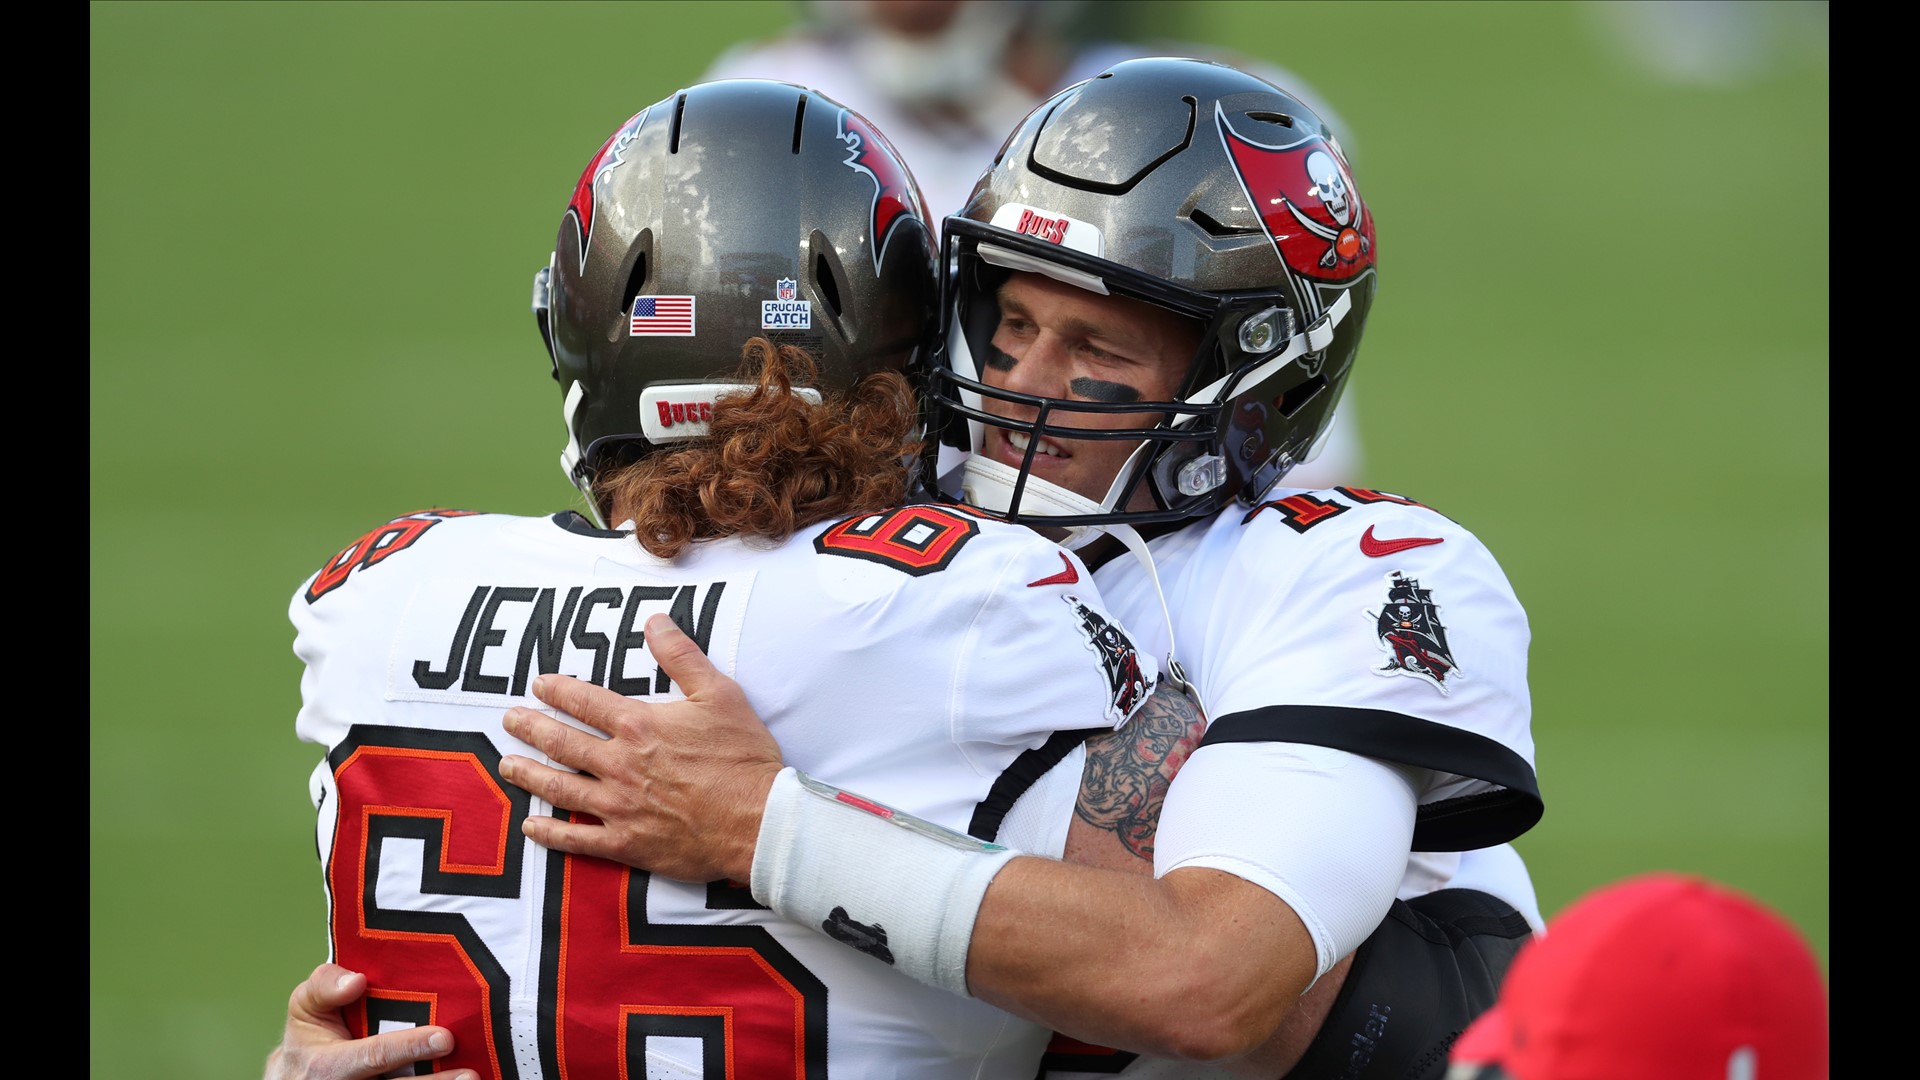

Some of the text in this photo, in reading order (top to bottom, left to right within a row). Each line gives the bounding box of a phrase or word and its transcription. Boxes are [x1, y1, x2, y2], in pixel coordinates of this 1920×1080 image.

[1016, 209, 1069, 244] BUCS
[780, 289, 794, 299] NFL
[764, 303, 808, 312] CRUCIAL
[764, 313, 808, 324] CATCH
[656, 400, 718, 427] BUCC
[412, 580, 727, 697] JENSEN
